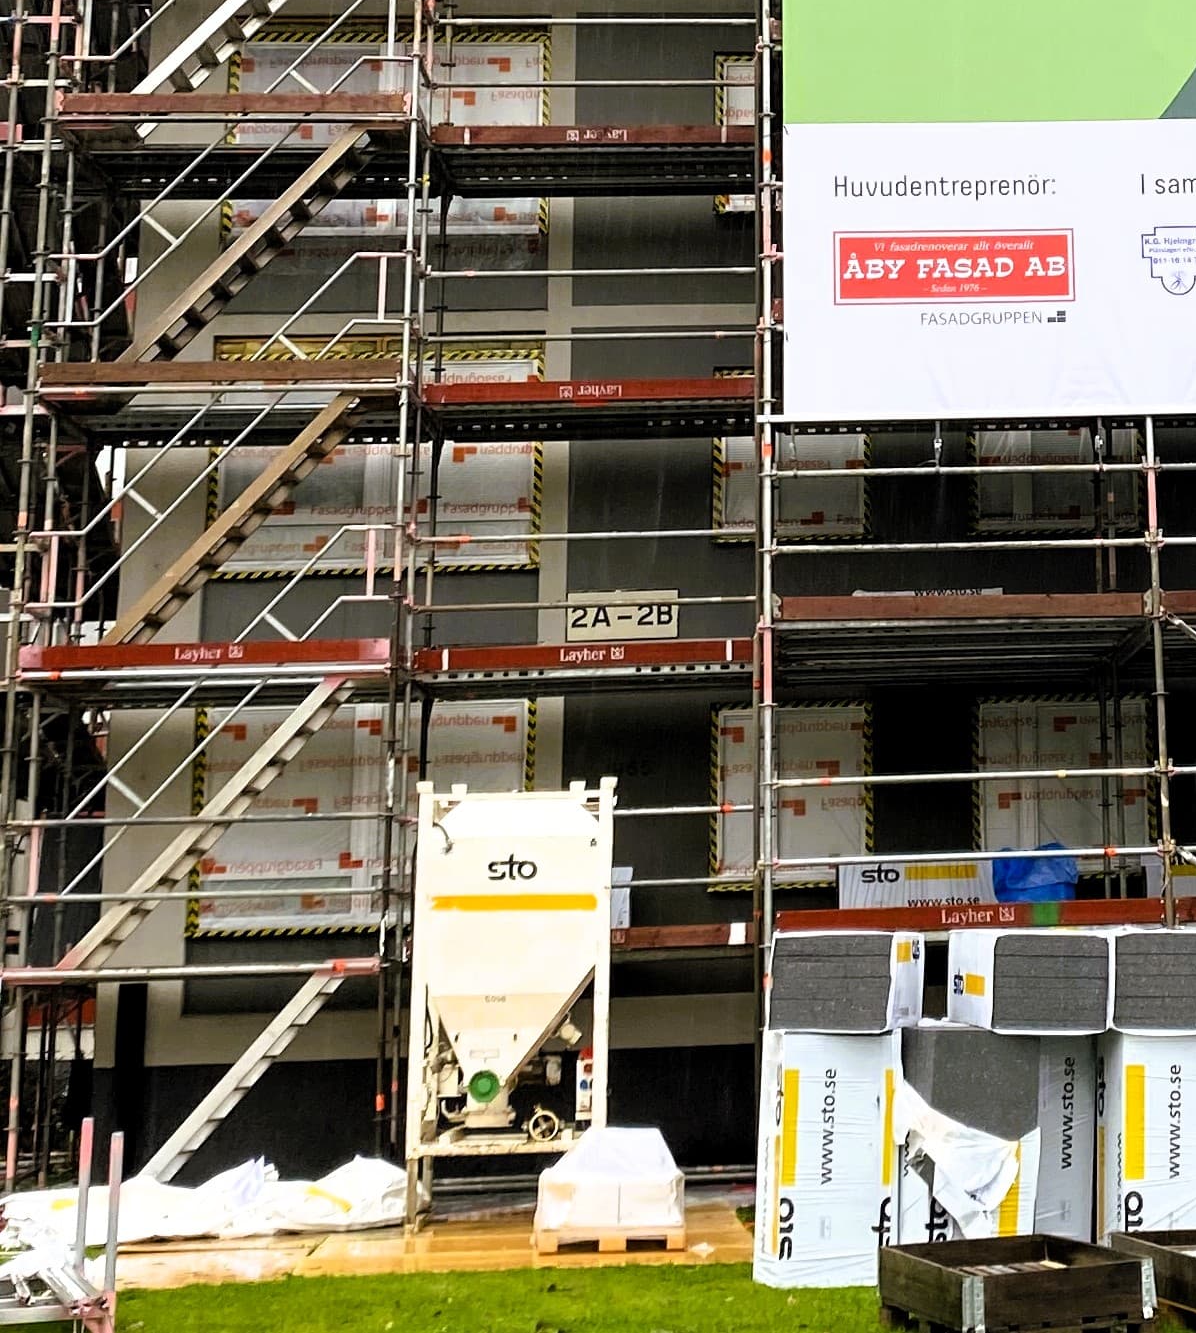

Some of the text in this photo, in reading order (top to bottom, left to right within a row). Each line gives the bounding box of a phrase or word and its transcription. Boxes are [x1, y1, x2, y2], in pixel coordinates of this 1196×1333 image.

[833, 173, 1057, 201] Huvudentreprenör:
[1140, 173, 1146, 195] I
[843, 252, 1067, 280] ÅBY FASAD AB
[920, 311, 1043, 326] FASADGRUPPEN
[174, 646, 222, 662] Layher
[559, 648, 607, 664] Layher
[487, 854, 538, 881] sto
[861, 863, 901, 884] sto
[940, 908, 994, 926] Layher
[1061, 1056, 1076, 1170] www.sto.se
[1169, 1064, 1182, 1180] www.sto.se
[820, 1068, 837, 1186] www.sto.se
